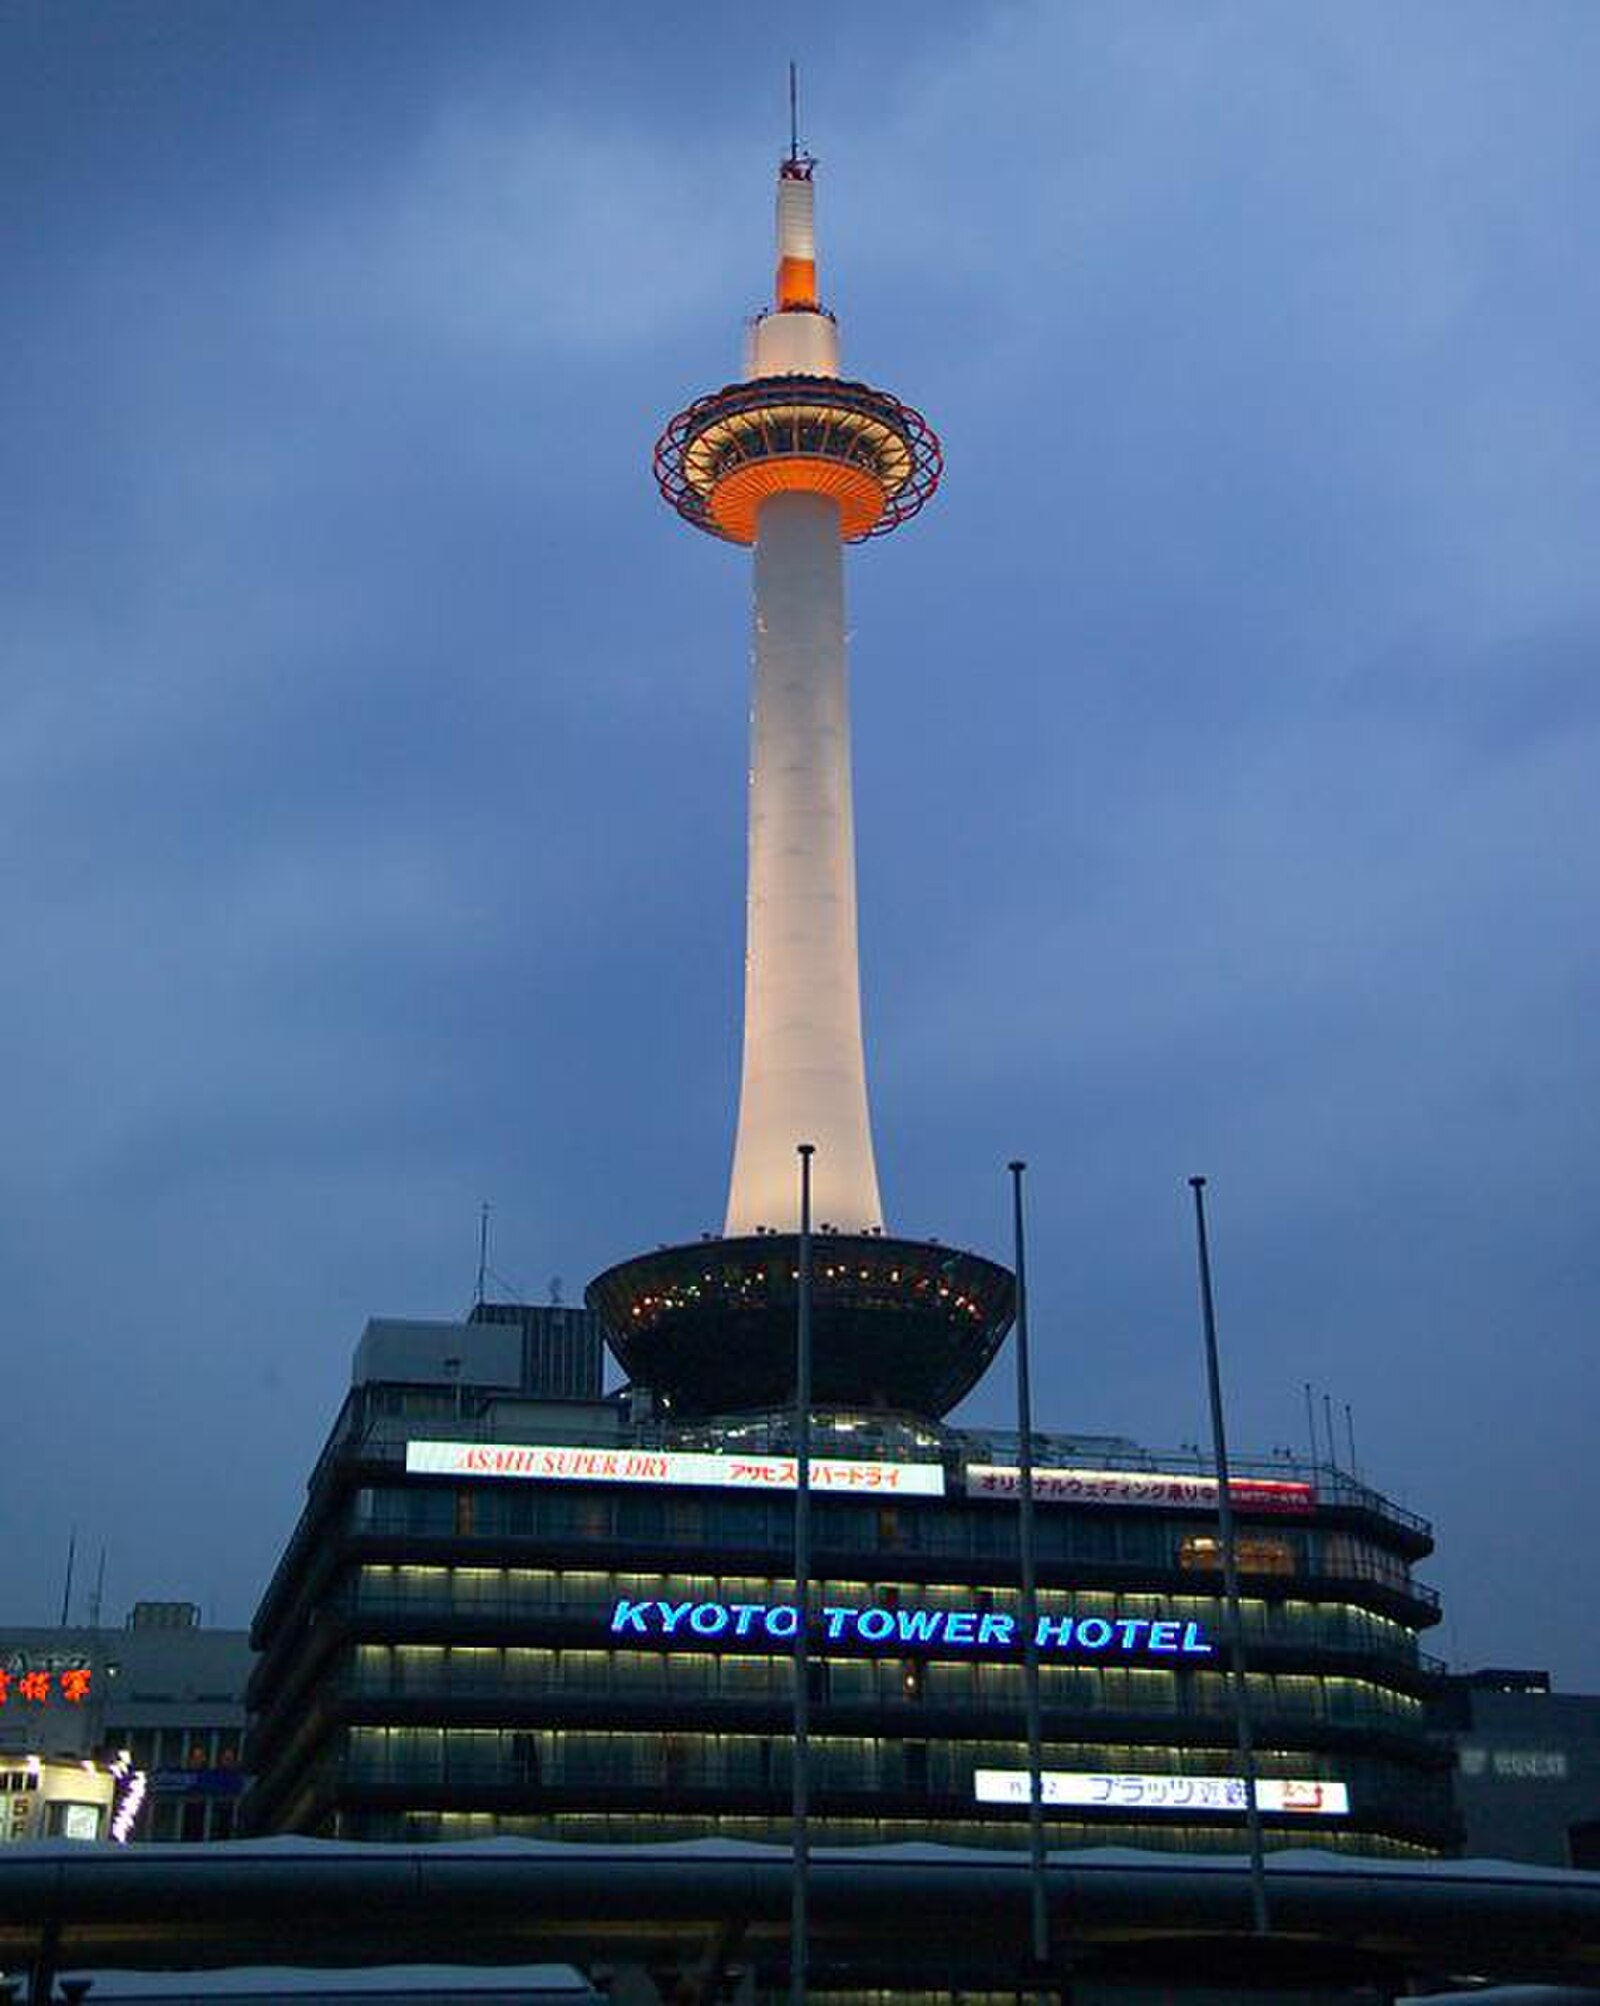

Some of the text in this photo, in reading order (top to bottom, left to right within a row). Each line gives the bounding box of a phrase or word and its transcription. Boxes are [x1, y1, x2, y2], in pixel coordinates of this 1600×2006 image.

[457, 1448, 673, 1478] ASAHI SUPER DRY
[610, 1600, 1213, 1652] KYOTO TOWER HOTEL
